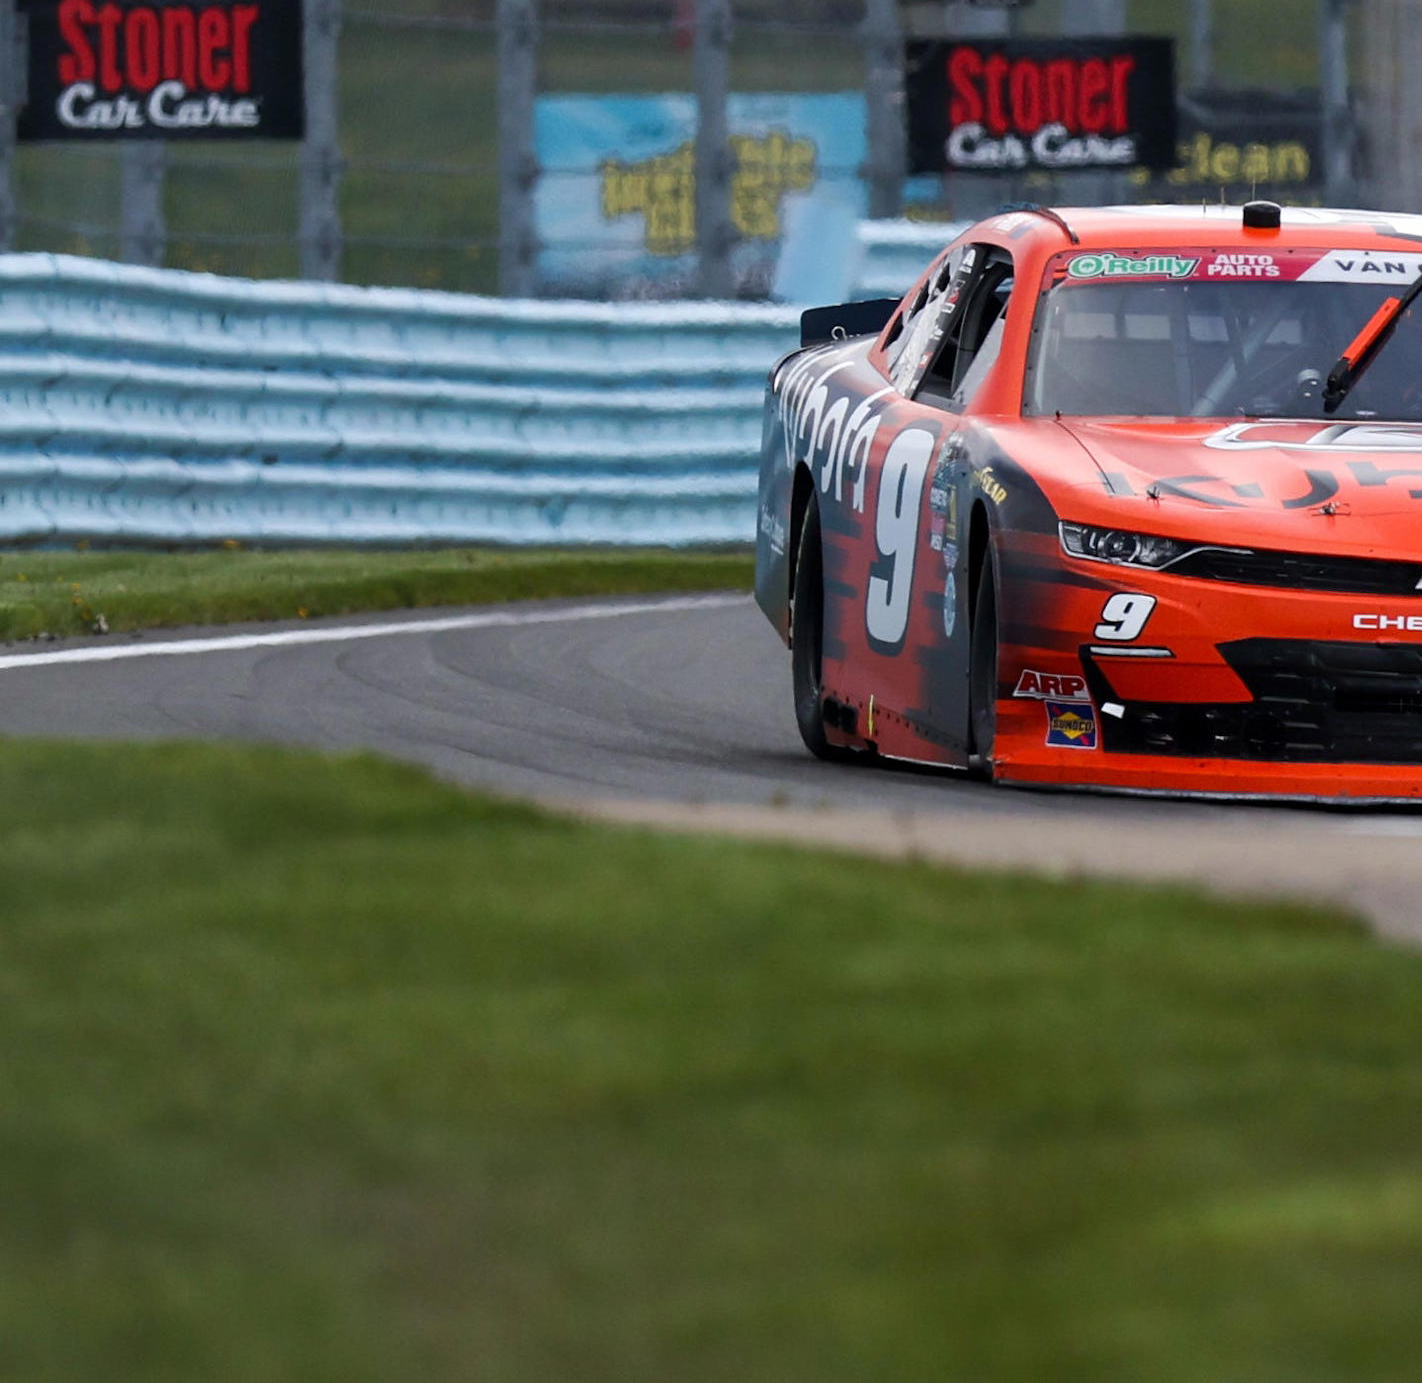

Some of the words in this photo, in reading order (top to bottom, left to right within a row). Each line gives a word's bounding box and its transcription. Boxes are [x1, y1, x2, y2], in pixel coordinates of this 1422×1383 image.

[57, 81, 146, 128] Car
[149, 79, 260, 128] Care
[948, 45, 1135, 137] Stoner
[946, 121, 1027, 167] Car
[1032, 121, 1136, 166] Care
[1069, 253, 1199, 279] O'Reilly
[1207, 264, 1281, 277] PARTS
[1214, 254, 1274, 266] AUTO
[1334, 259, 1406, 275] VAN
[865, 427, 936, 644] 9
[1093, 591, 1158, 641] 9
[1017, 671, 1086, 697] ARP
